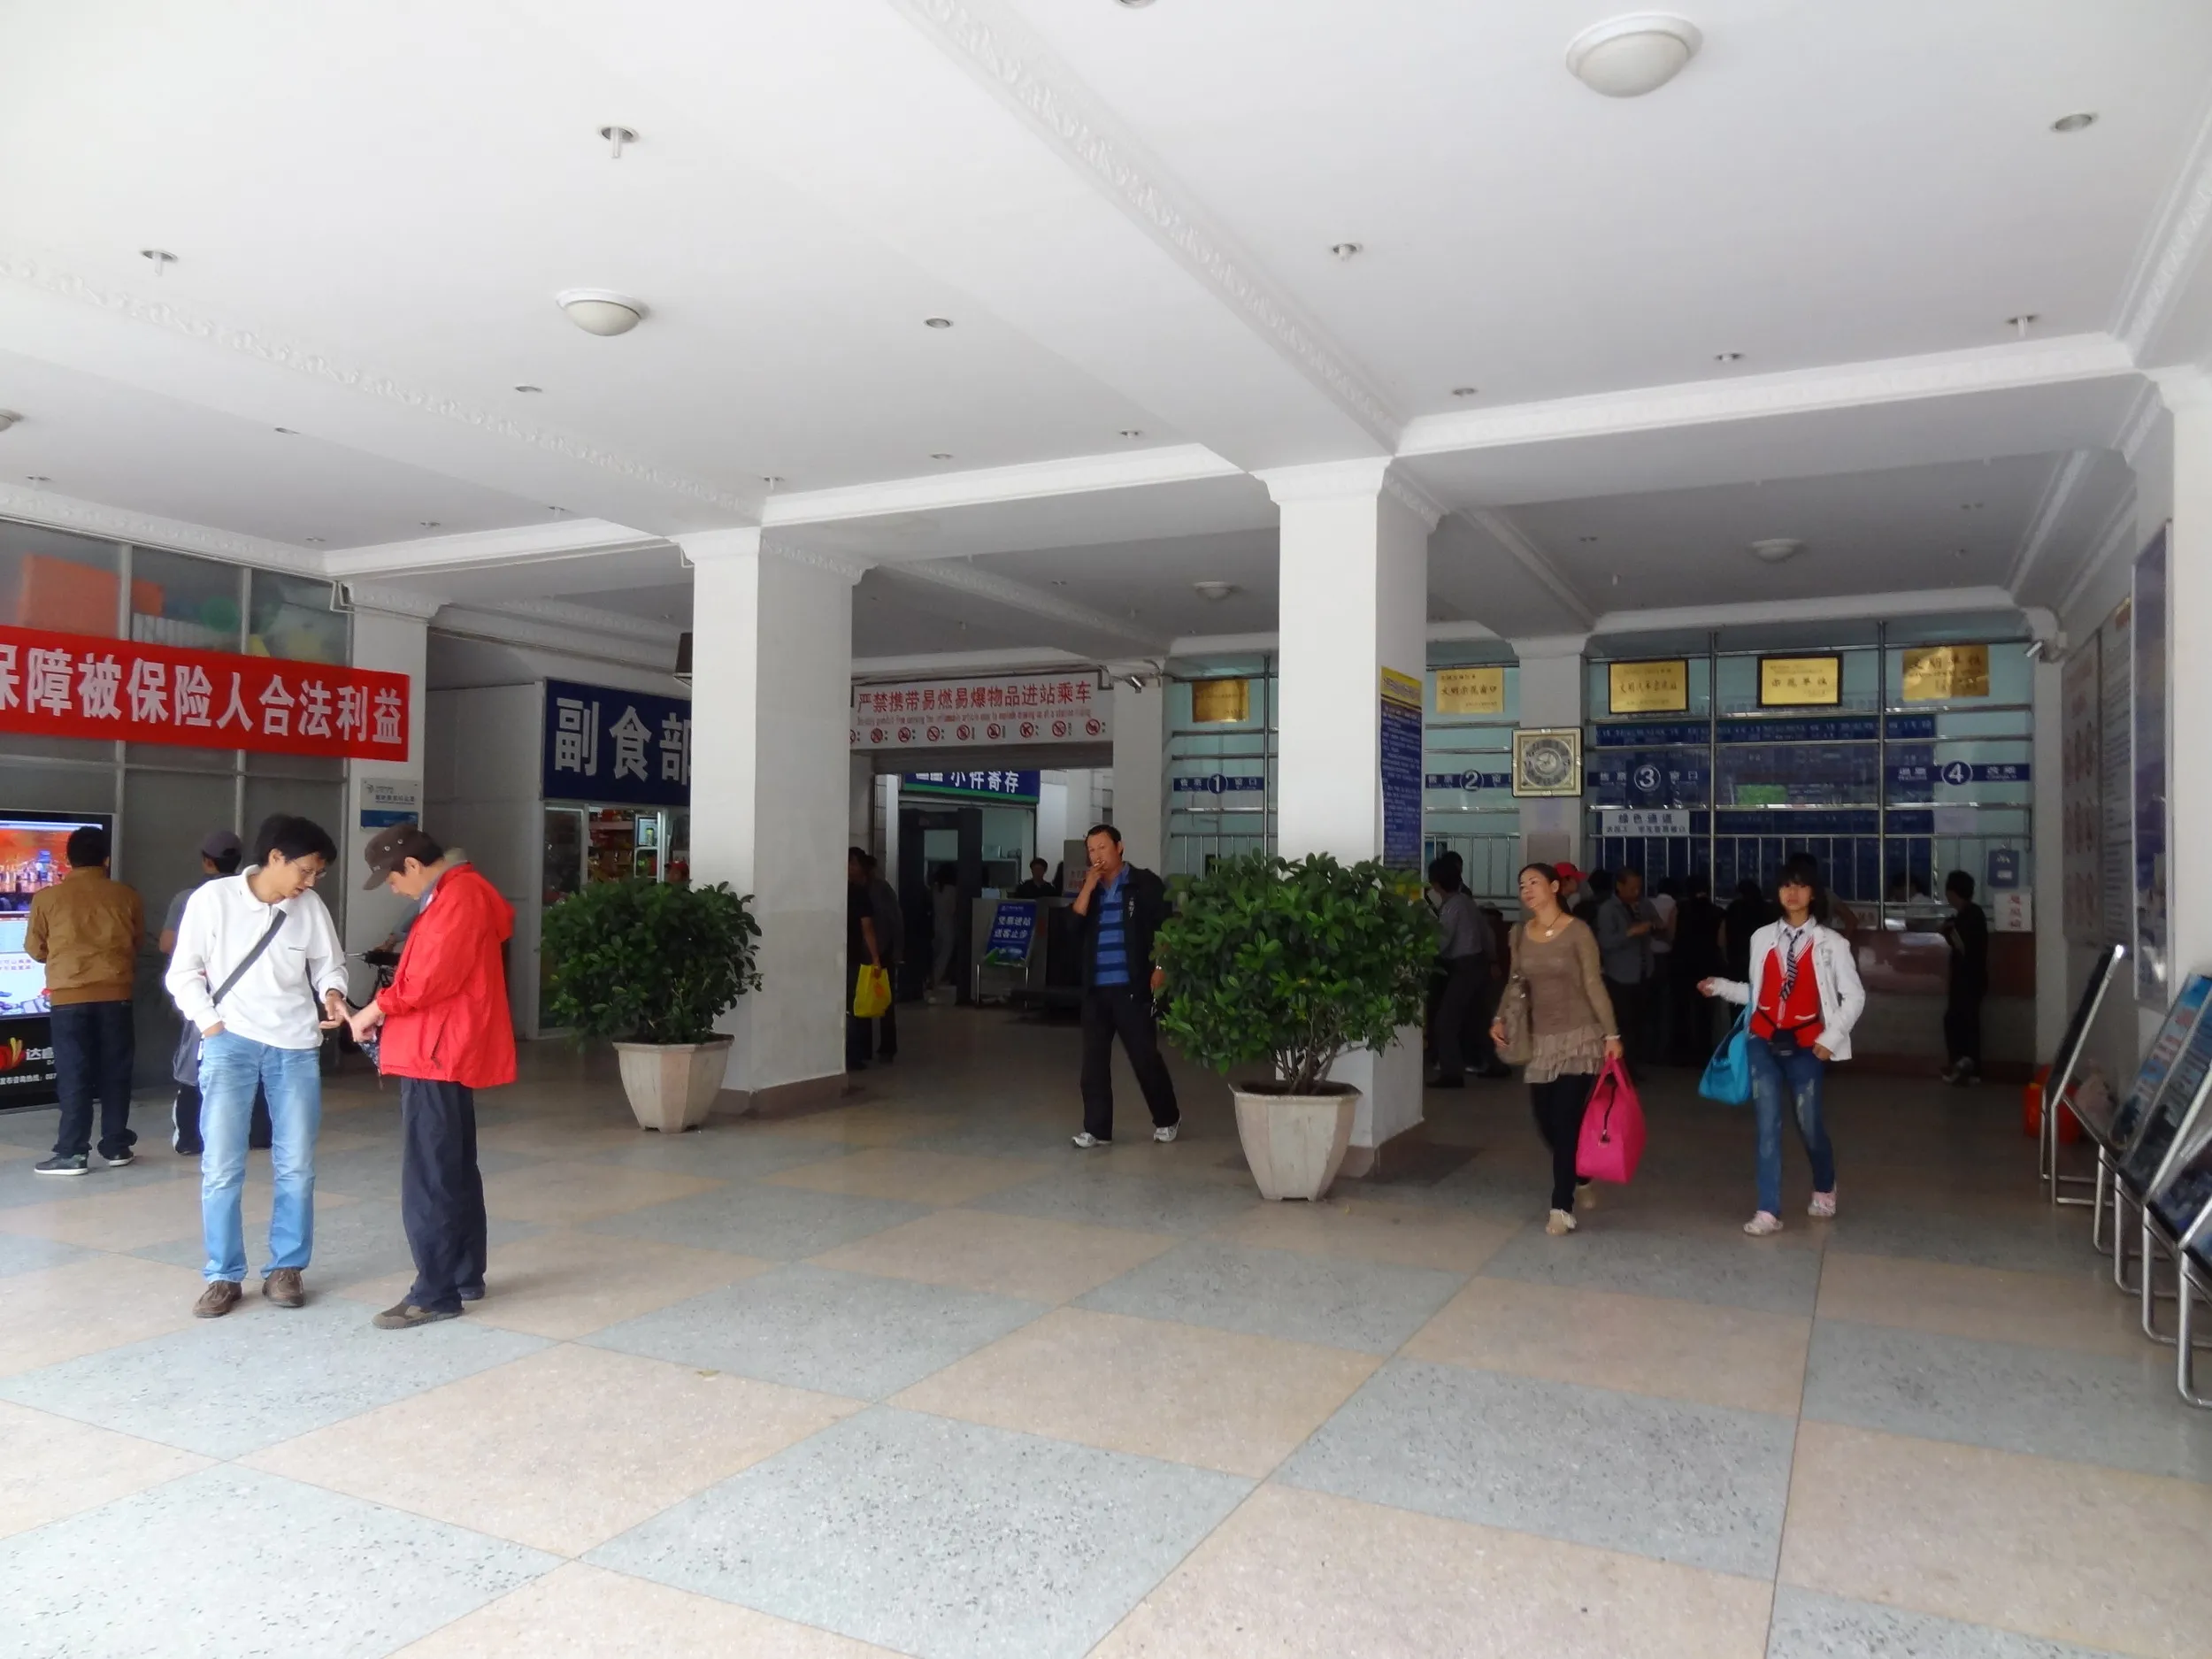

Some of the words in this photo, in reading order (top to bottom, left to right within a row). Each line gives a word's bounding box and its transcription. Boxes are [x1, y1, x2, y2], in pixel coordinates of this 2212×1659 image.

[857, 680, 1091, 713] 严禁携带易燃易爆物品进站乘车
[555, 697, 691, 785] 副食部
